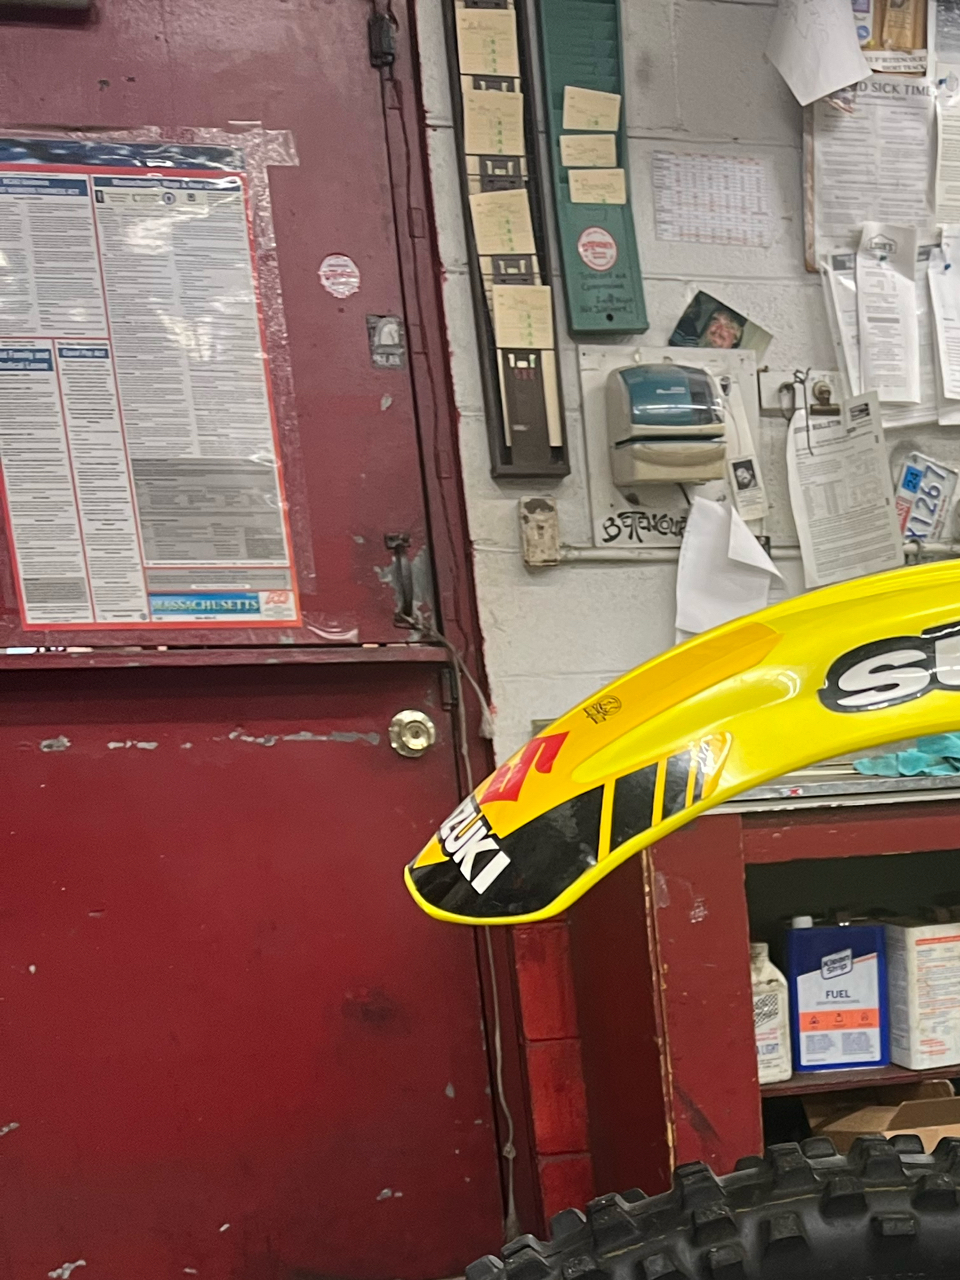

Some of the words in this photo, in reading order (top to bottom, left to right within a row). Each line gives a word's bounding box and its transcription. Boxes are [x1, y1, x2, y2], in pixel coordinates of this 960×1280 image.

[871, 82, 901, 95] SICK
[906, 470, 920, 491] 24
[823, 954, 851, 967] Klean
[826, 962, 848, 975] Strip
[825, 989, 851, 999] FUEL
